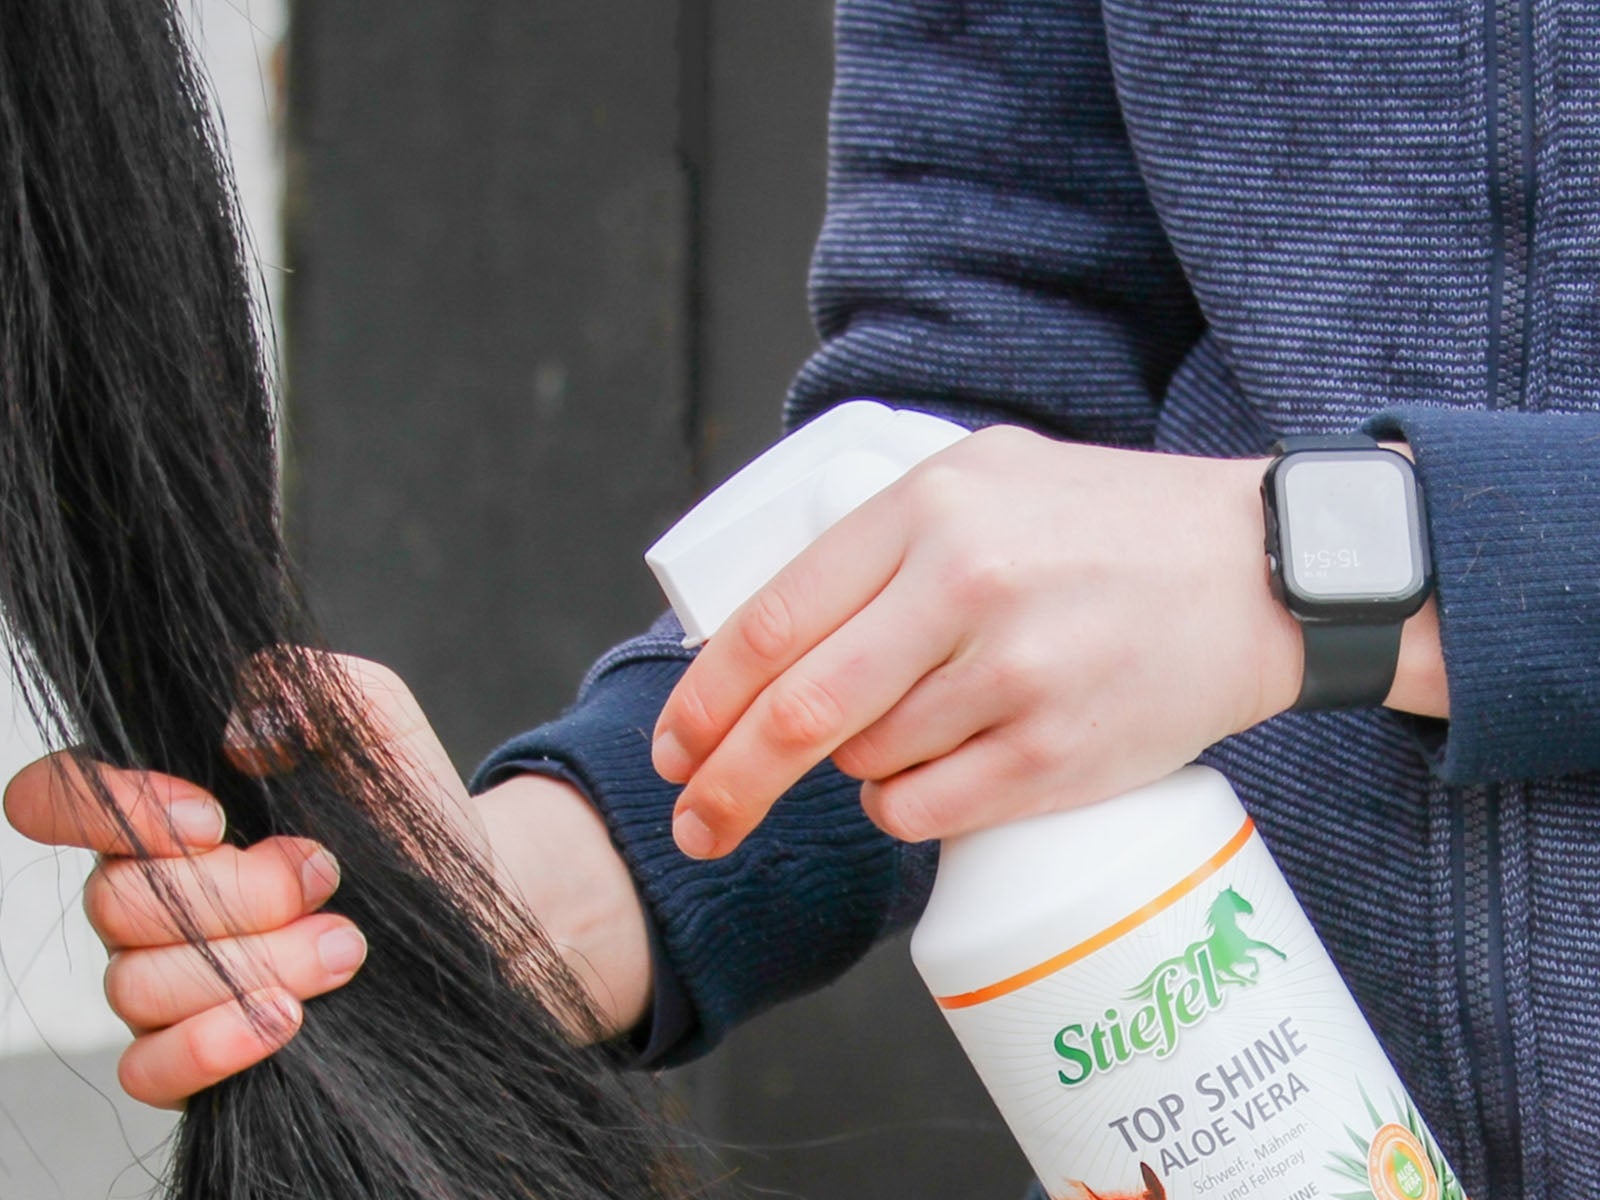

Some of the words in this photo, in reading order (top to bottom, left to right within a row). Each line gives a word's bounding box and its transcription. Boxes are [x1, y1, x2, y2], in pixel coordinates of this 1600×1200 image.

[1053, 948, 1222, 1085] Stiefel
[1108, 1093, 1184, 1153] TOP
[1195, 1016, 1308, 1113] SHINE
[1159, 1117, 1236, 1177] ALOE
[1231, 1072, 1310, 1131] VERA
[1248, 1149, 1306, 1190] Fellspray
